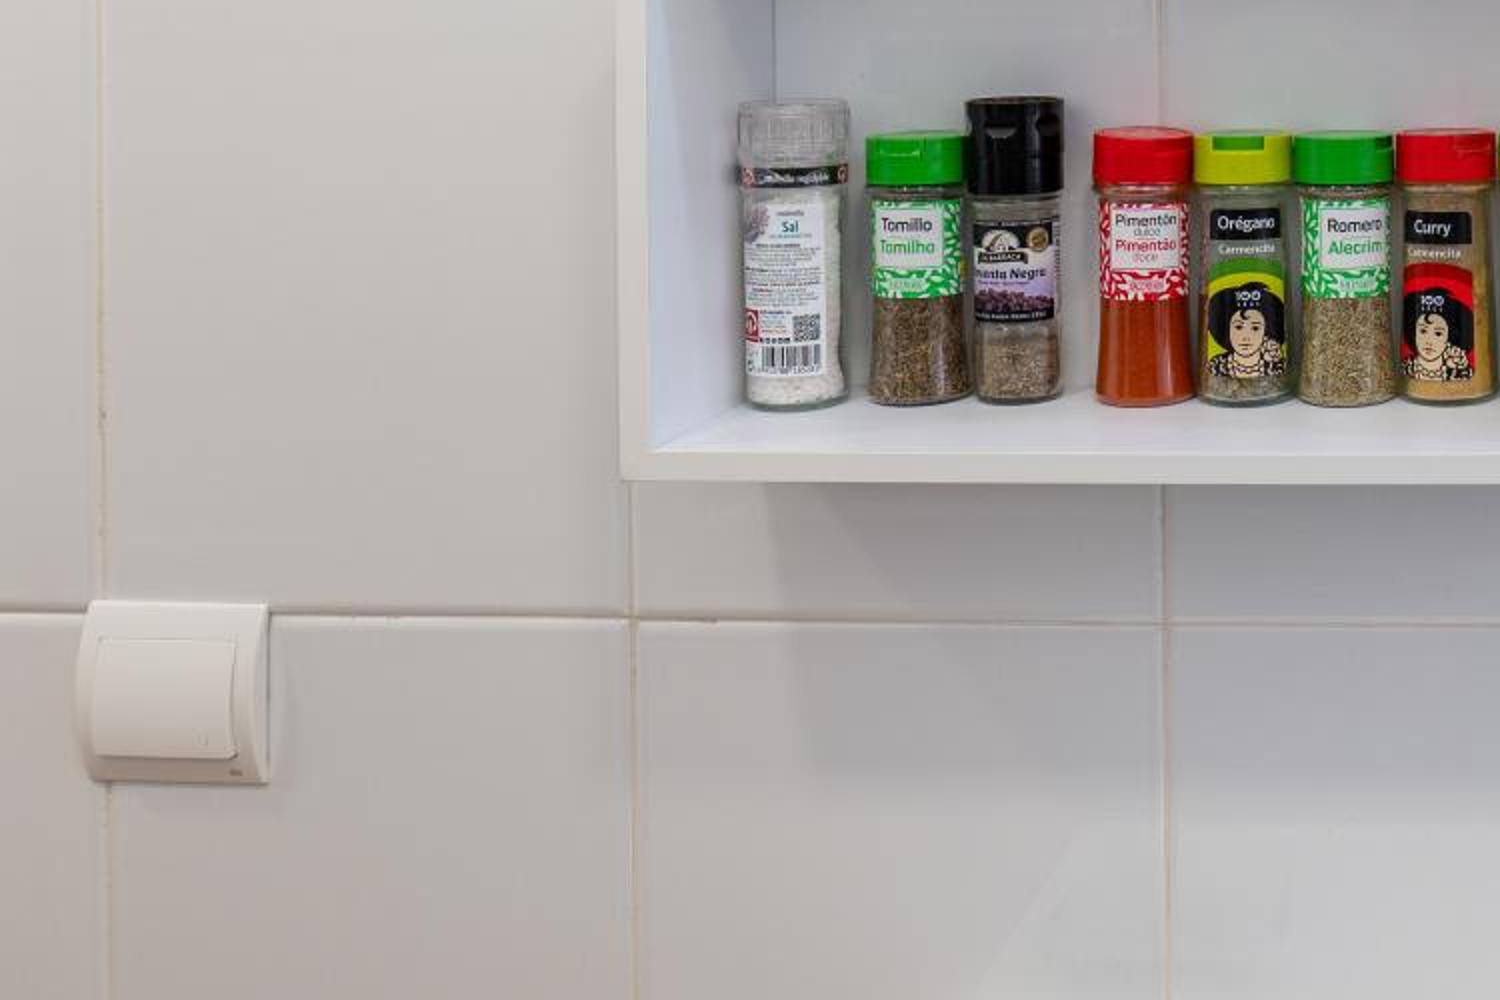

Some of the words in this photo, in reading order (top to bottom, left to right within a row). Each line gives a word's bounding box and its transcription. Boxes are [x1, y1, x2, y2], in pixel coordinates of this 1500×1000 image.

[782, 220, 799, 233] Sal
[882, 217, 932, 233] Tomillo
[1115, 213, 1177, 227] Pimentón
[1217, 215, 1275, 233] Orégano
[1327, 219, 1383, 234] Romero
[1413, 219, 1451, 238] Curry
[881, 238, 935, 255] Tomilho
[1329, 240, 1383, 255] Alecrim
[1010, 266, 1047, 281] Negra
